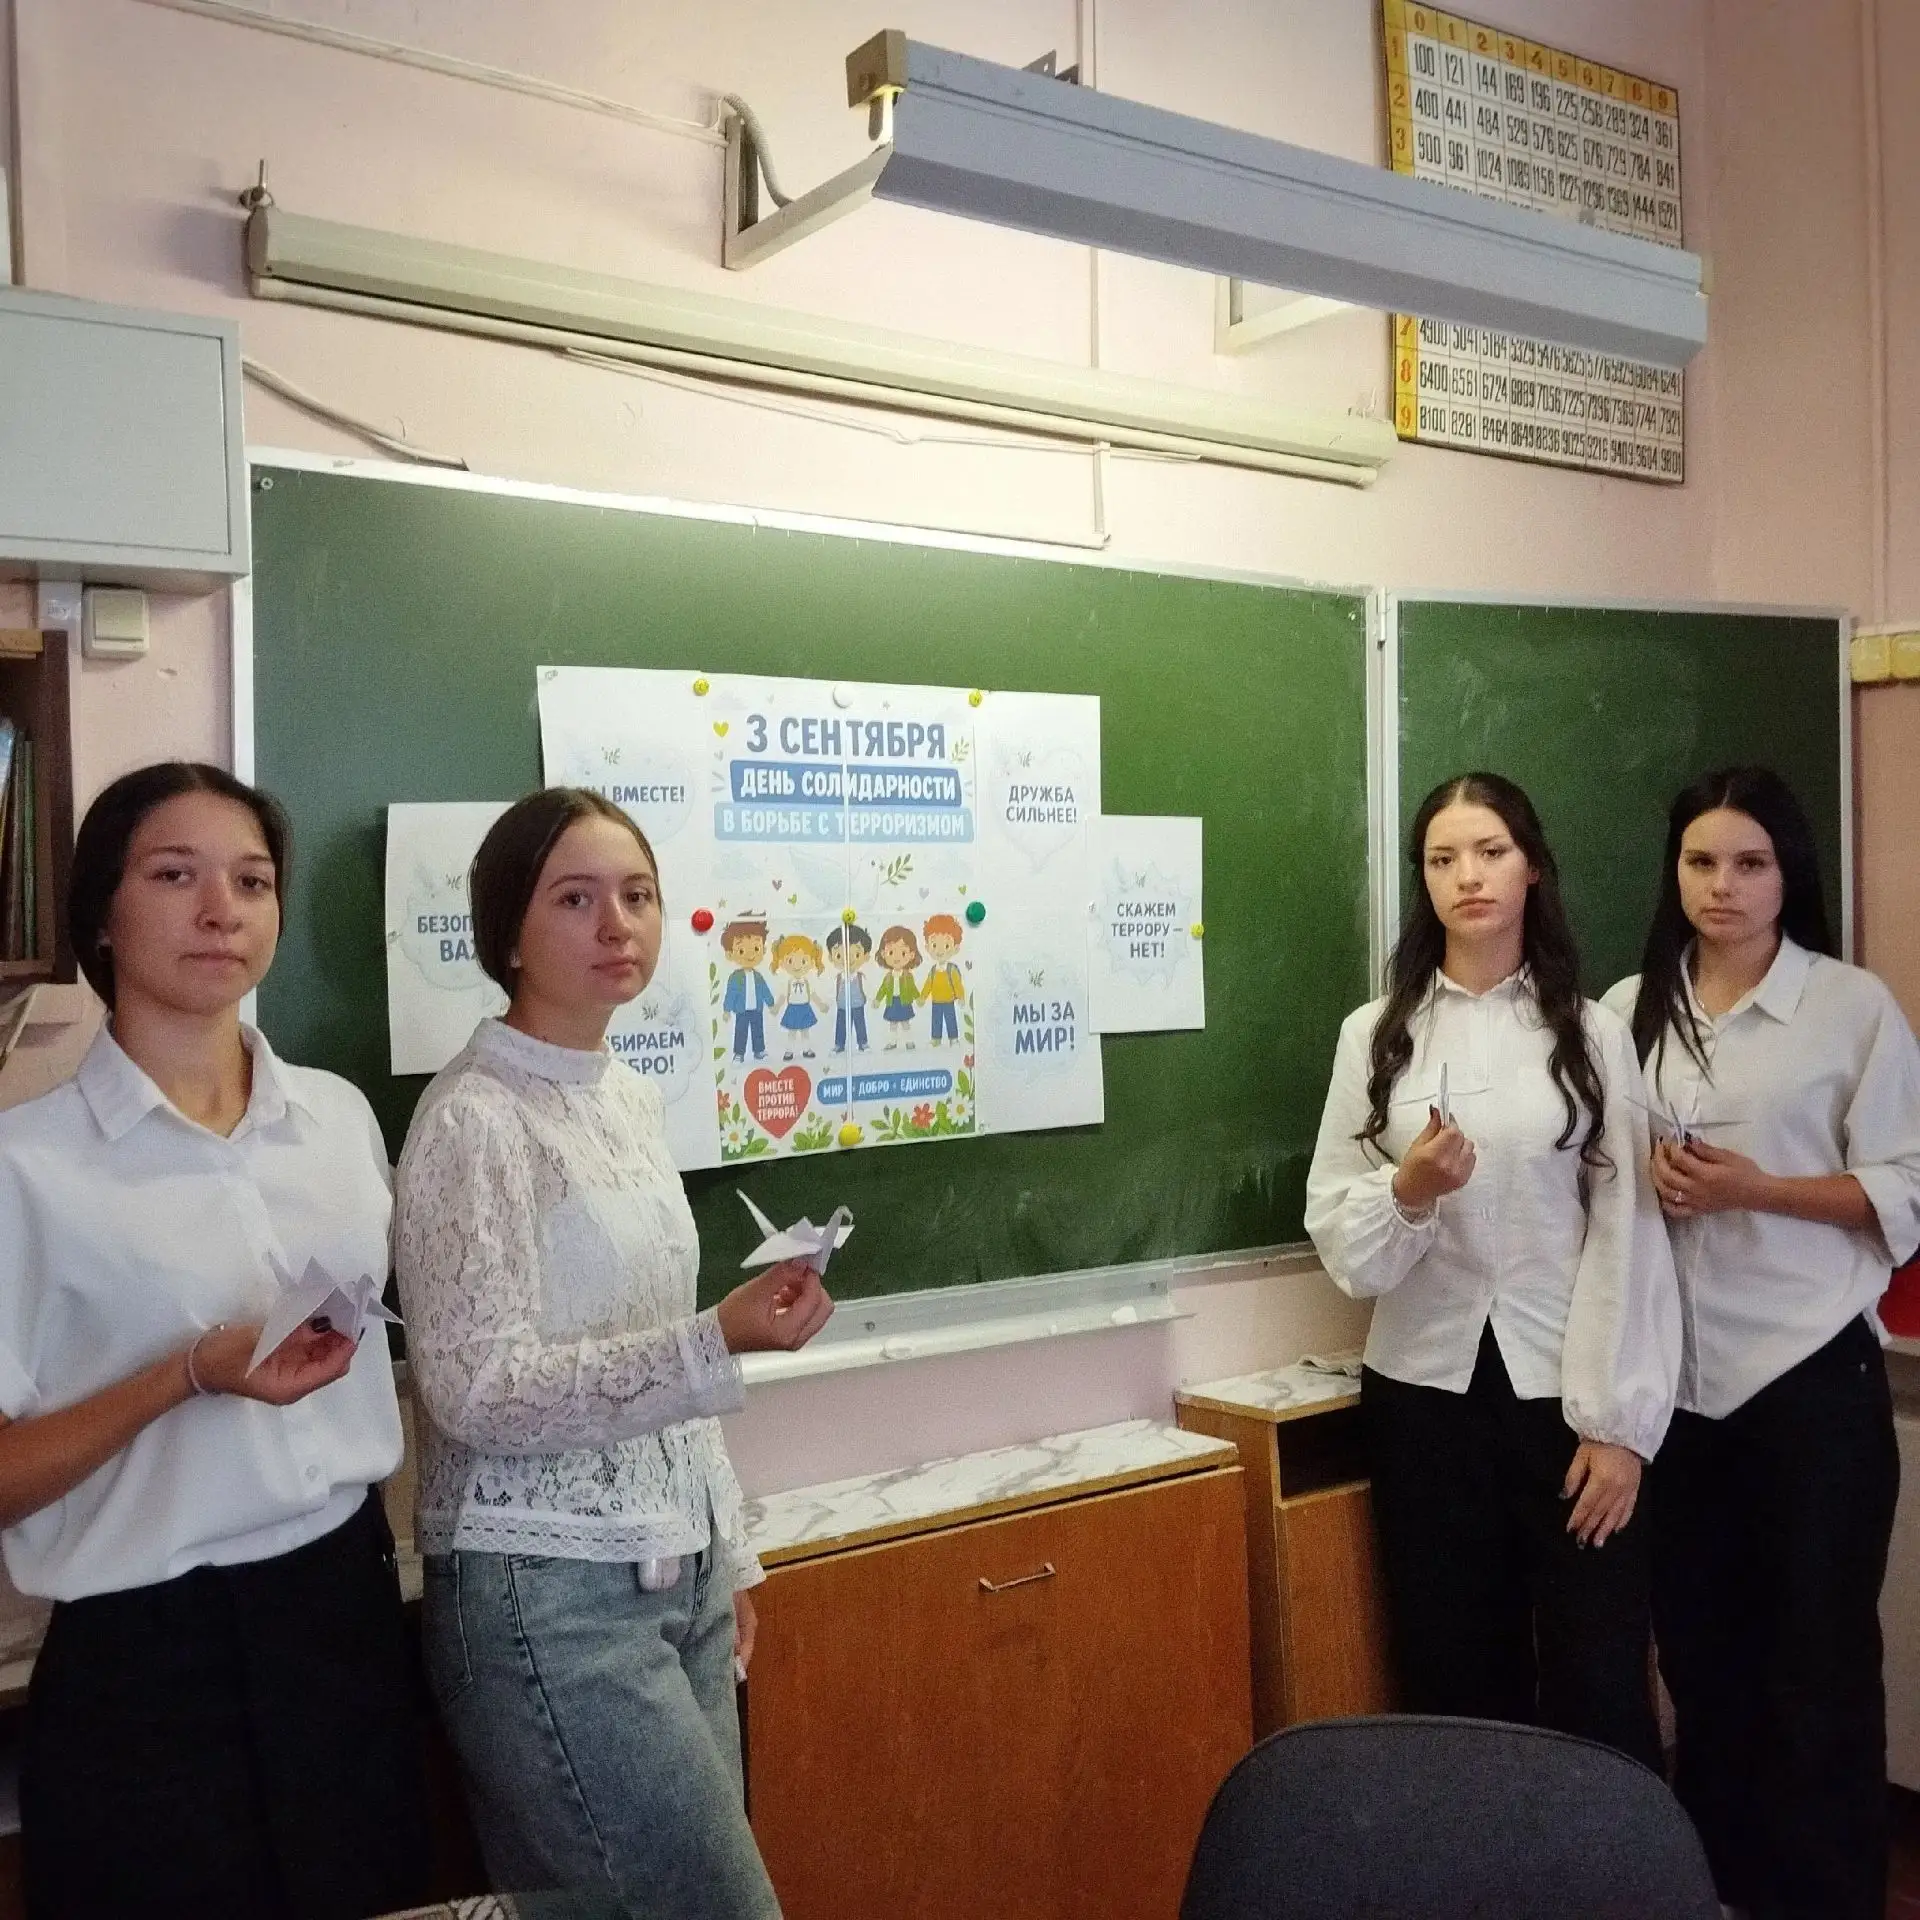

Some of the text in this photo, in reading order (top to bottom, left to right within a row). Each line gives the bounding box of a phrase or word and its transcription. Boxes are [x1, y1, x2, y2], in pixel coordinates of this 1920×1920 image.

[1414, 10, 1668, 109] 0 1 2 3 4 5 6 7 8 9
[1392, 36, 1673, 149] 1 100 121 144 169 196 225 256 289 324 361
[1394, 84, 1675, 191] 2 400 441 484 529 576 625 676 729 784 841
[1395, 128, 1405, 150] 3
[1418, 131, 1442, 165] 900
[1448, 140, 1469, 174] 961
[1477, 147, 1502, 183] 1024
[1507, 156, 1530, 190] 1089
[1533, 164, 1555, 197] 1156
[1583, 179, 1605, 211] 1296
[1633, 193, 1655, 224] 1444
[1658, 200, 1677, 231] 1521
[1400, 316, 1412, 336] 7
[1420, 318, 1448, 347] 4900
[1453, 324, 1478, 354] 5041
[1482, 331, 1508, 359] 5184
[1400, 359, 1411, 383] 8
[1420, 360, 1448, 392] 6400
[1452, 367, 1478, 397] 6561
[1482, 372, 1508, 403] 6724
[1511, 378, 1535, 408] 6889
[1537, 382, 1561, 414] 7056
[1562, 388, 1585, 418] 7225
[1635, 403, 1657, 433] 7744
[1400, 405, 1412, 429] 9
[1420, 406, 1446, 433] 8100
[1451, 410, 1477, 440] 8281
[1482, 416, 1508, 444] 8464
[1511, 421, 1534, 448] 8649
[1536, 426, 1560, 452] 8836
[1562, 430, 1584, 457] 9025
[1587, 434, 1608, 461] 9216
[1660, 448, 1680, 475] 9801
[746, 714, 946, 759] 3 СЕНТЯБРЯ
[612, 785, 685, 802] ВМЕСТЕ!
[740, 768, 956, 802] ДЕНЬ СОЛИДАРНОСТИ
[1008, 785, 1075, 804] ДРУЖБА
[723, 808, 965, 837] В БОРЬБЕ С ТЕРРОРИЗМОМ
[1006, 806, 1078, 824] СИЛЬНЕЕ!
[1116, 902, 1176, 917] СКАЖЕМ
[417, 915, 473, 933] БЕЗОП
[1111, 922, 1170, 938] ТЕРРОРУ
[1130, 942, 1165, 958] НЕТ!
[1013, 1001, 1075, 1025] МЫ ЗА
[605, 1031, 685, 1052] БИРАЕМ
[1015, 1026, 1075, 1055] МИР!
[758, 1077, 795, 1094] ВМЕСТЕ
[823, 1075, 947, 1098] МИР ДОБРО ЕДИНСТВО
[758, 1092, 796, 1108] ПРОТИВ
[757, 1105, 799, 1122] ТЕРРОРА!
